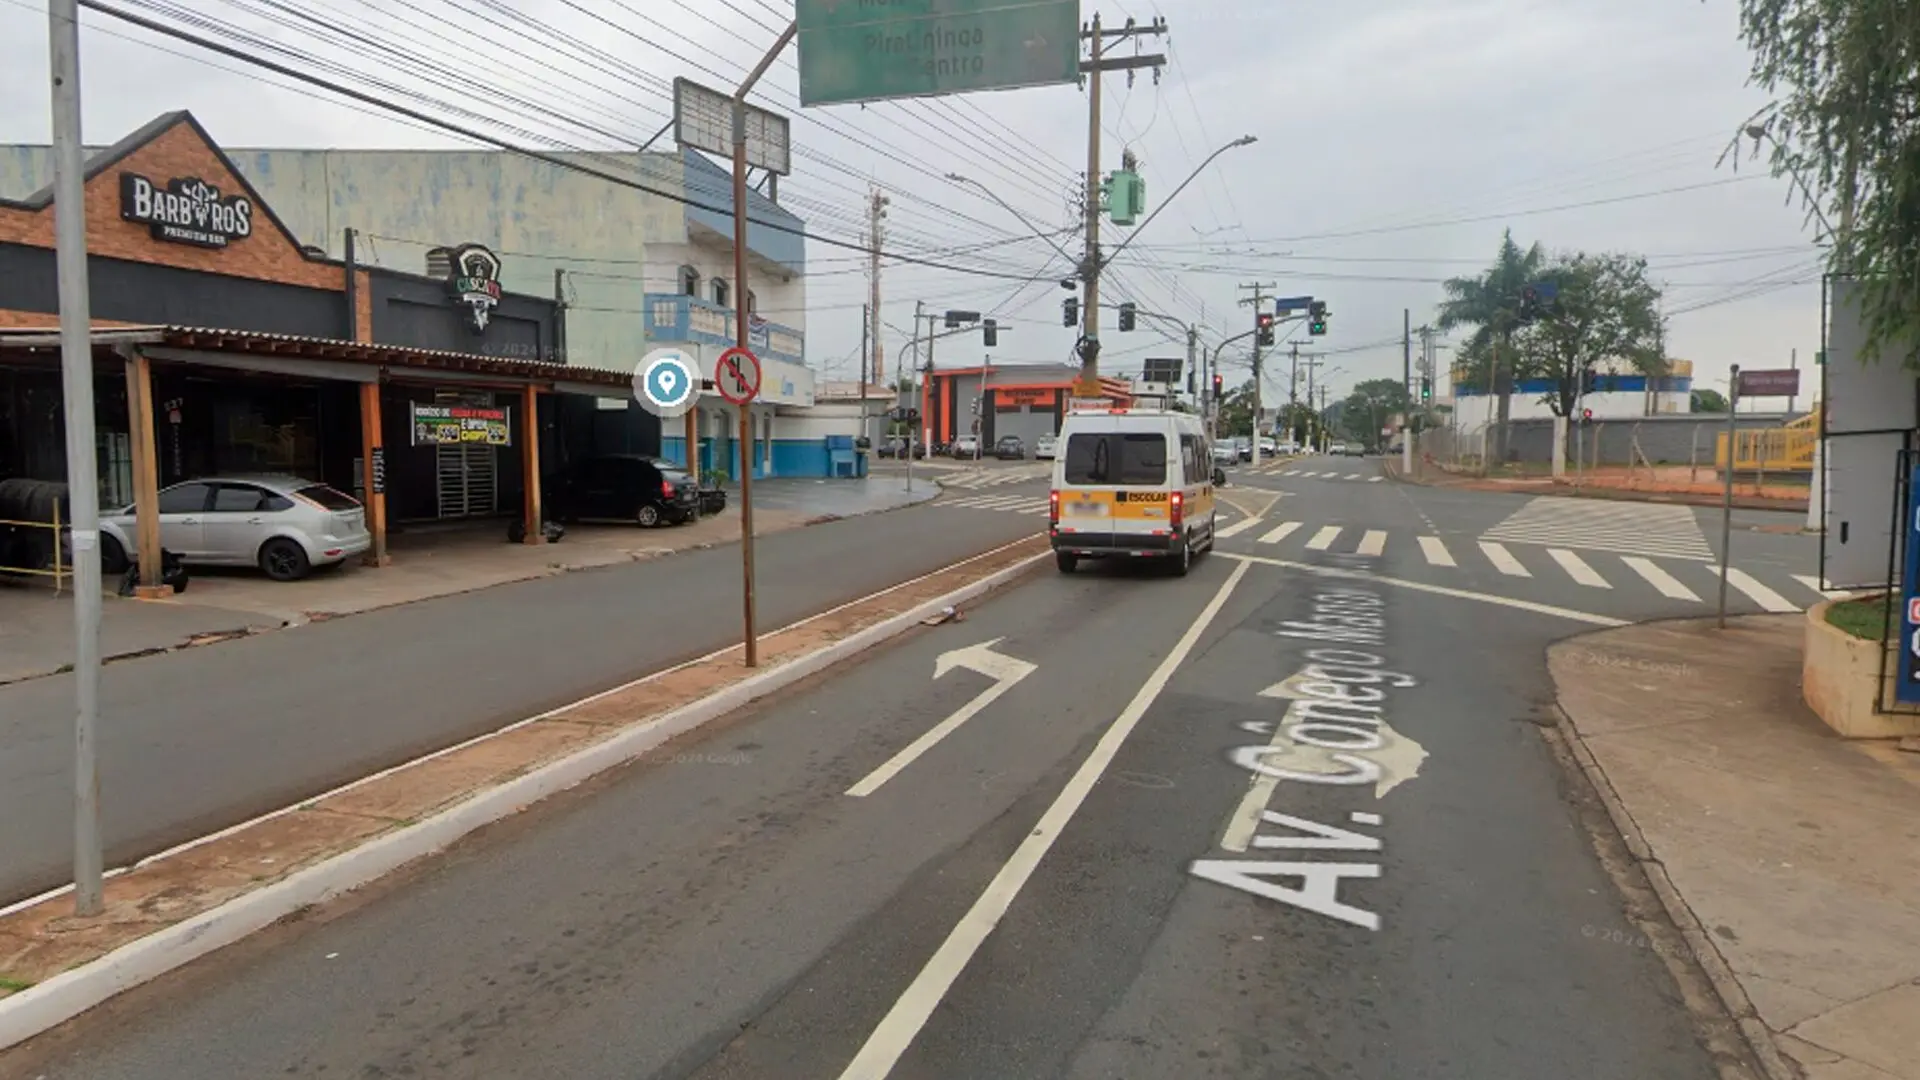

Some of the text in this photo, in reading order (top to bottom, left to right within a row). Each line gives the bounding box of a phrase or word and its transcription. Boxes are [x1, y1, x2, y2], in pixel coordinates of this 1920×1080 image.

[864, 25, 984, 55] Piratninga
[914, 55, 984, 76] entro
[164, 226, 207, 241] PREMIUM
[1129, 491, 1168, 502] ESCOLAR
